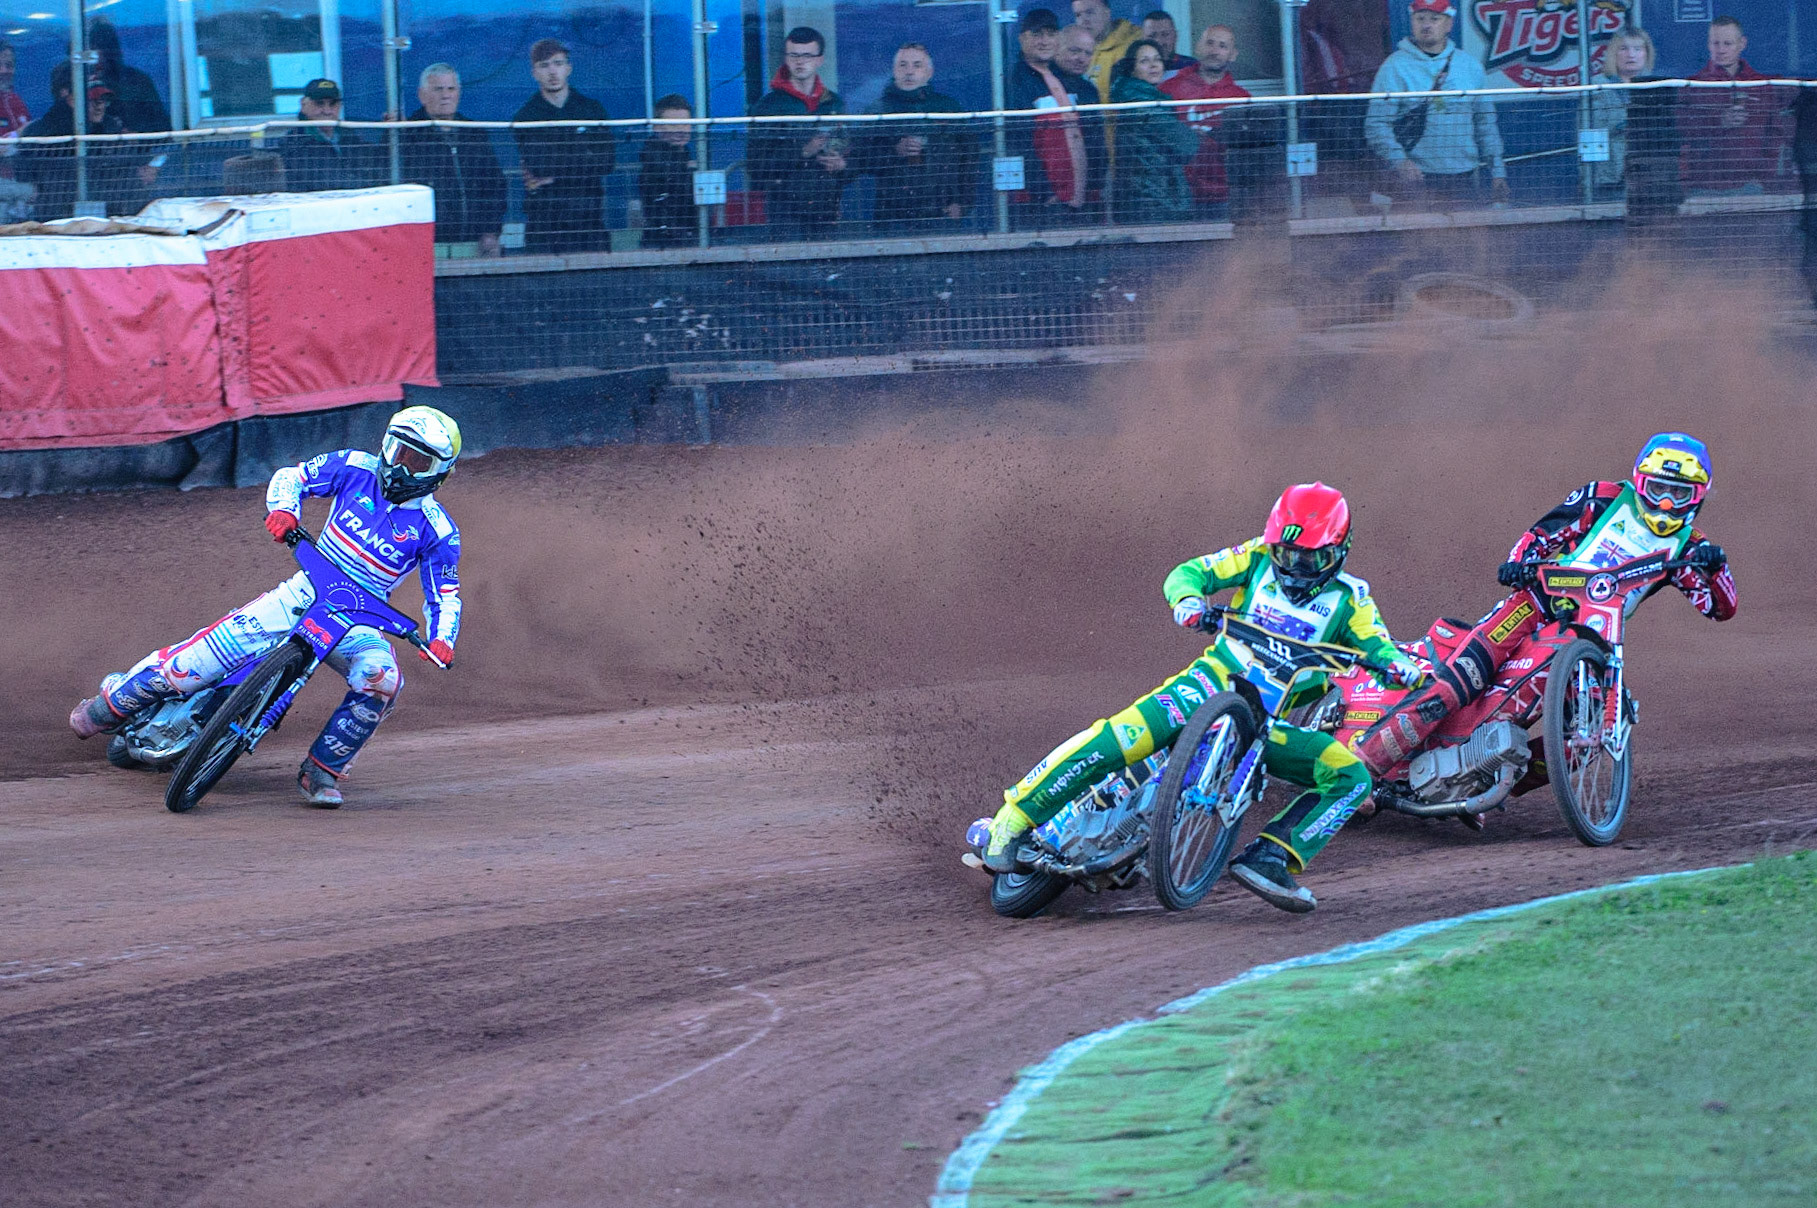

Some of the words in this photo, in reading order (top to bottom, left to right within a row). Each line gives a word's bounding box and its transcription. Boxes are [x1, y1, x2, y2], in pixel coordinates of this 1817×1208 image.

[1476, 0, 1626, 56] Tigers
[339, 509, 405, 564] FRANCE
[1309, 603, 1331, 618] AUS
[298, 624, 329, 651] FILTRATION
[1048, 751, 1105, 796] MONSTER
